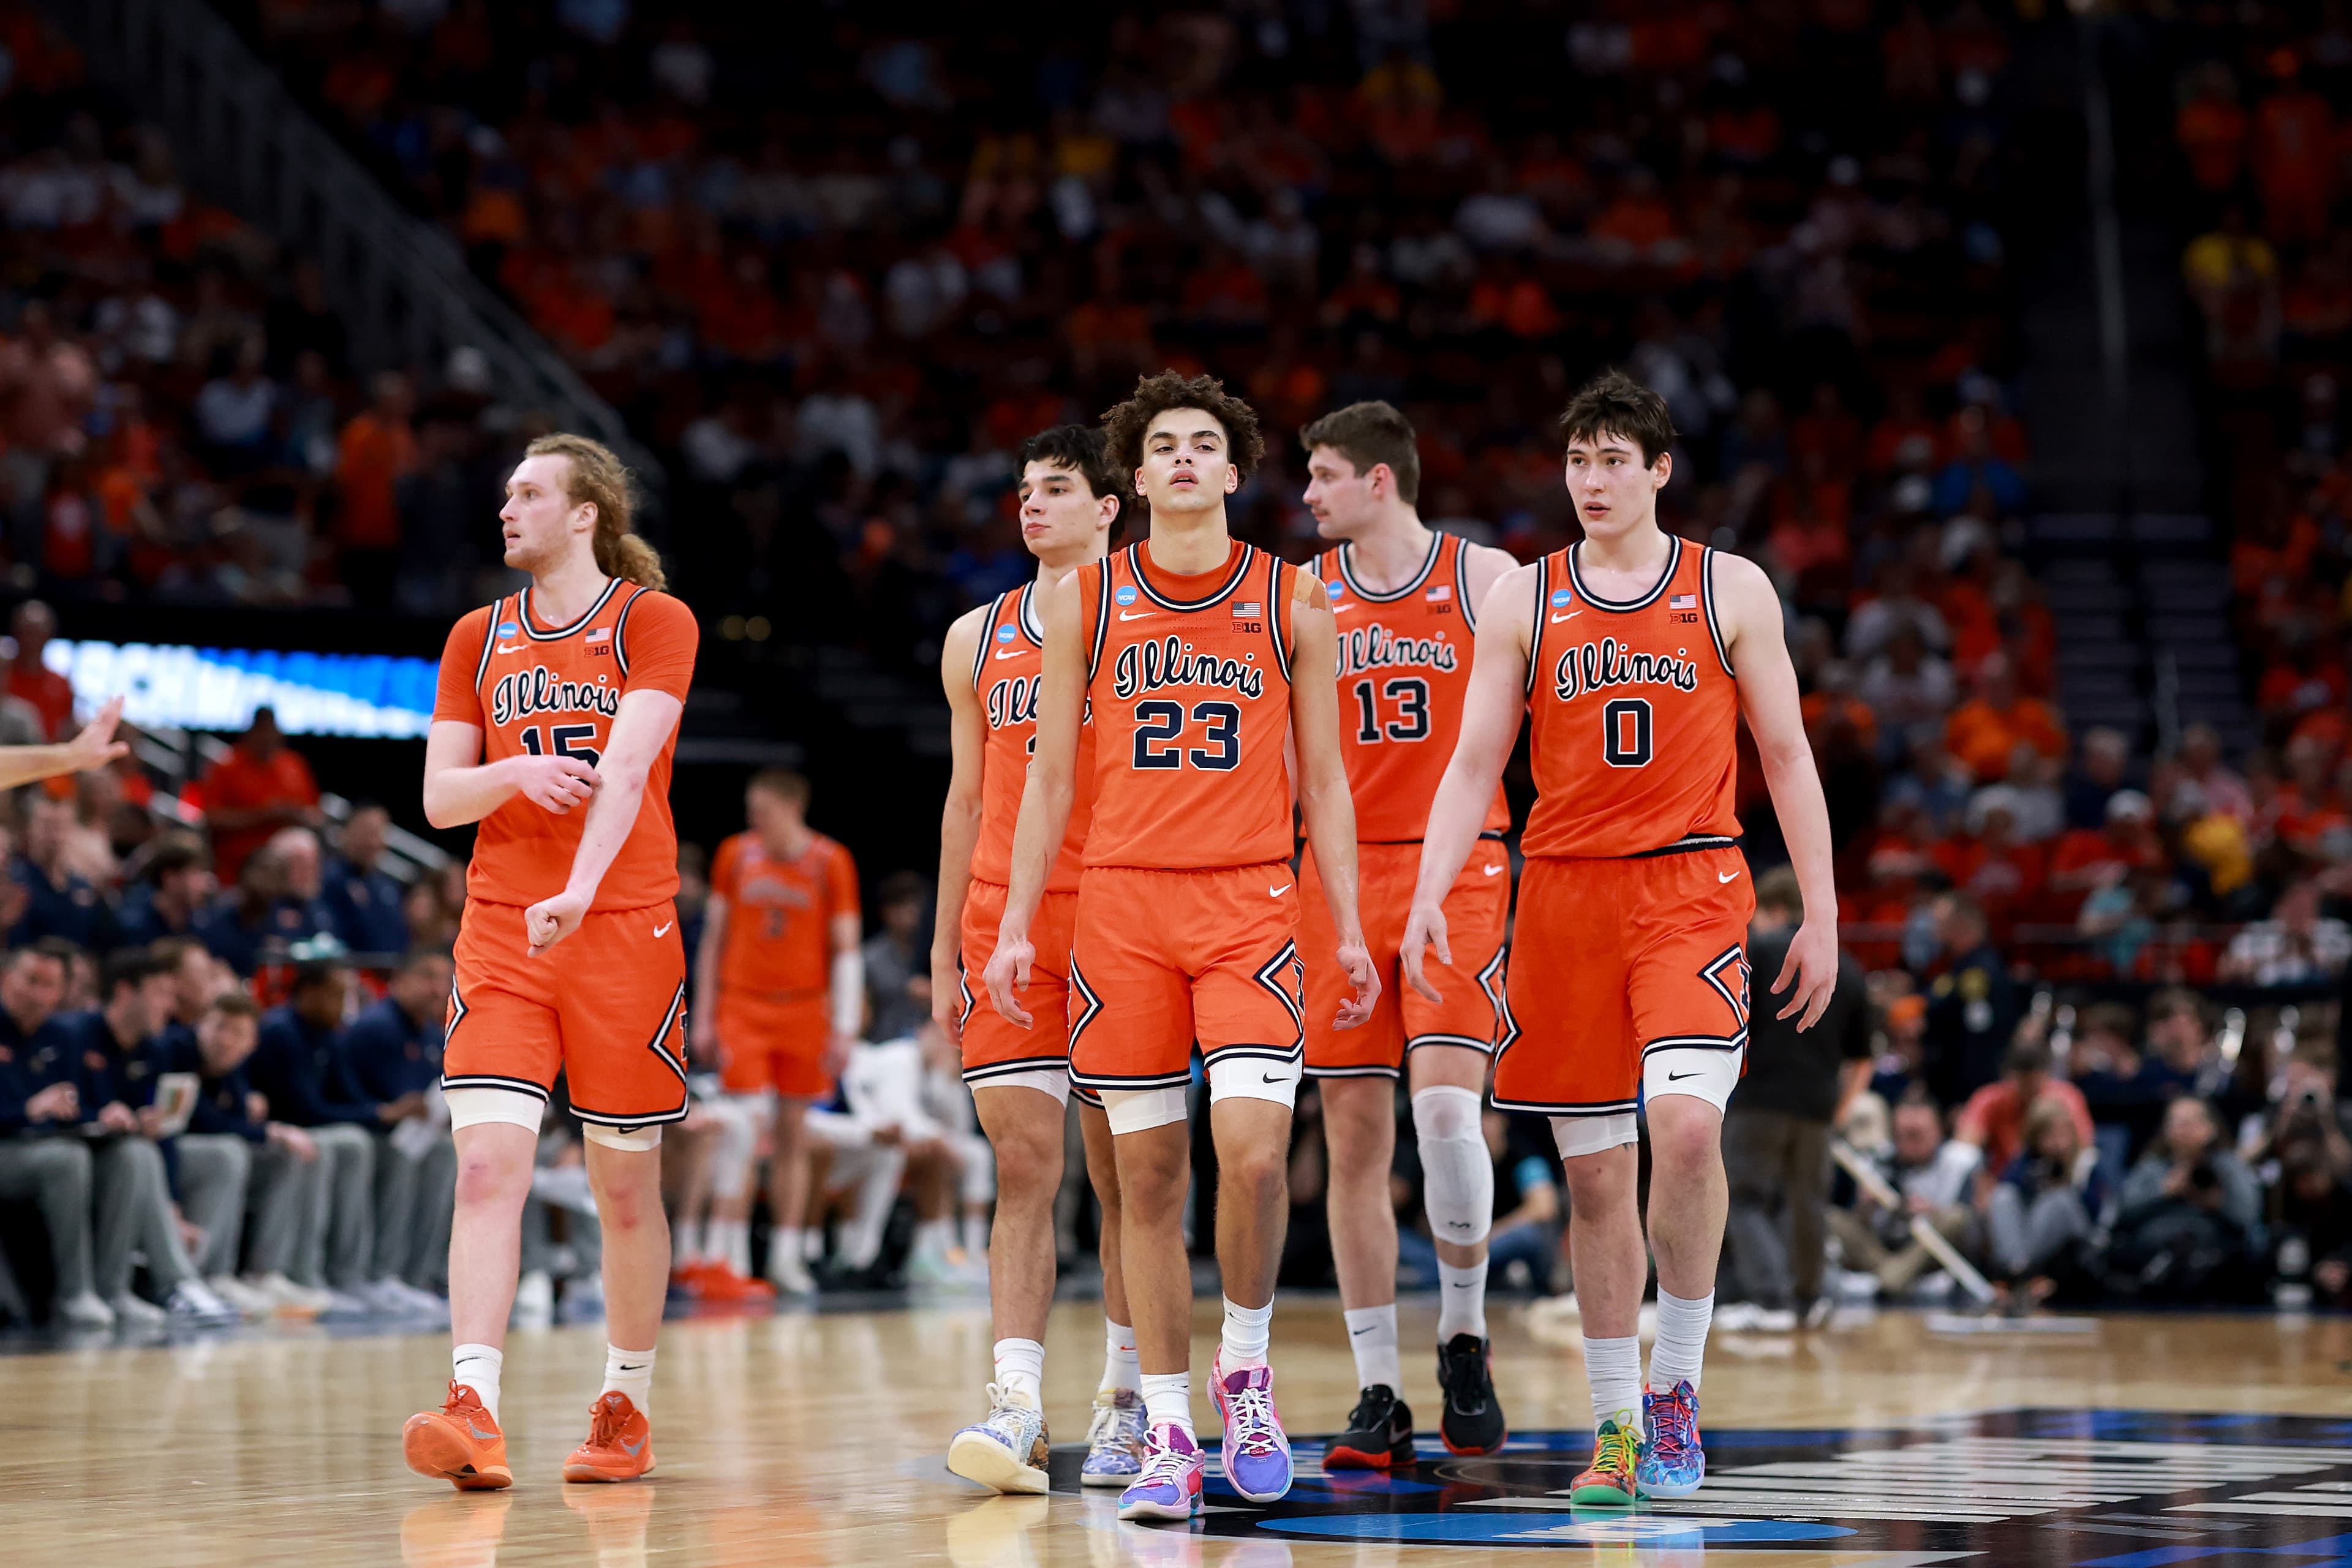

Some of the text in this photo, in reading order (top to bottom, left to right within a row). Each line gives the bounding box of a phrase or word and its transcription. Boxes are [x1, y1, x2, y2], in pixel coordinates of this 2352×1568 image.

[492, 665, 620, 728] Illinois
[1113, 634, 1264, 700] Illinois
[1555, 636, 1698, 701] Illinois
[1132, 699, 1242, 772] 23
[1353, 677, 1431, 745] 13
[1603, 698, 1653, 767] 0
